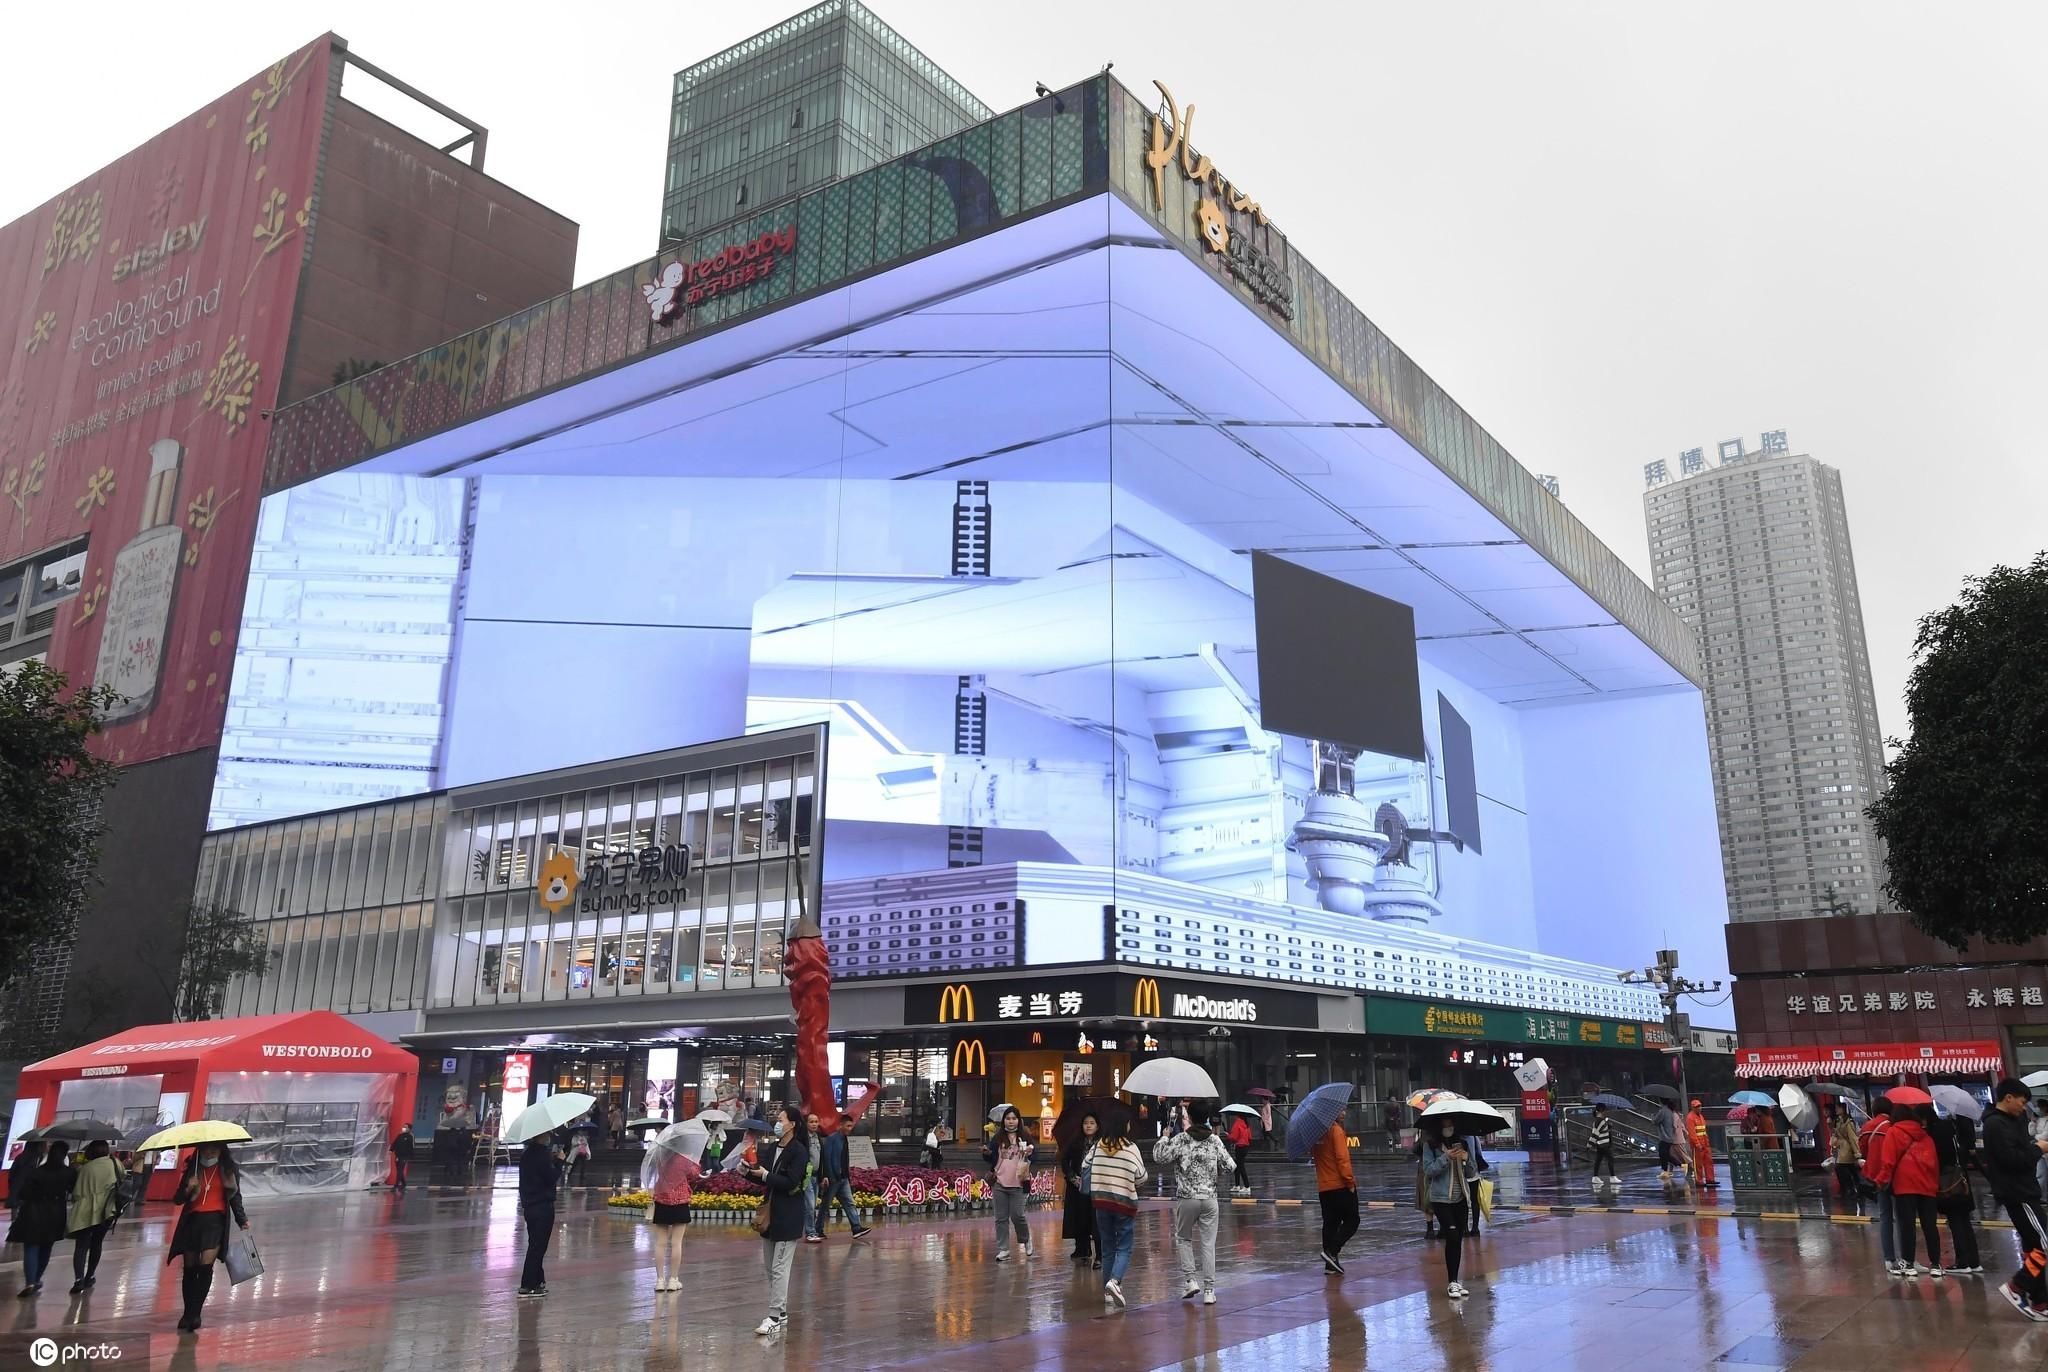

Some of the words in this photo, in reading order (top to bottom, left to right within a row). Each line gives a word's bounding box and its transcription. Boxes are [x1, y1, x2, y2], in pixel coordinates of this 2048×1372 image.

[111, 213, 207, 281] sisley
[71, 266, 190, 350] ecological
[91, 279, 222, 366] compound
[1644, 429, 1789, 486] 拜博口腔
[581, 887, 687, 914] suning.com
[998, 991, 1083, 1018] 麦当劳
[1173, 993, 1257, 1021] McDonald's
[1787, 991, 1937, 1015] 华谊兄弟影院
[1966, 987, 2044, 1009] 永辉超
[262, 1045, 373, 1058] WESTONBOLO
